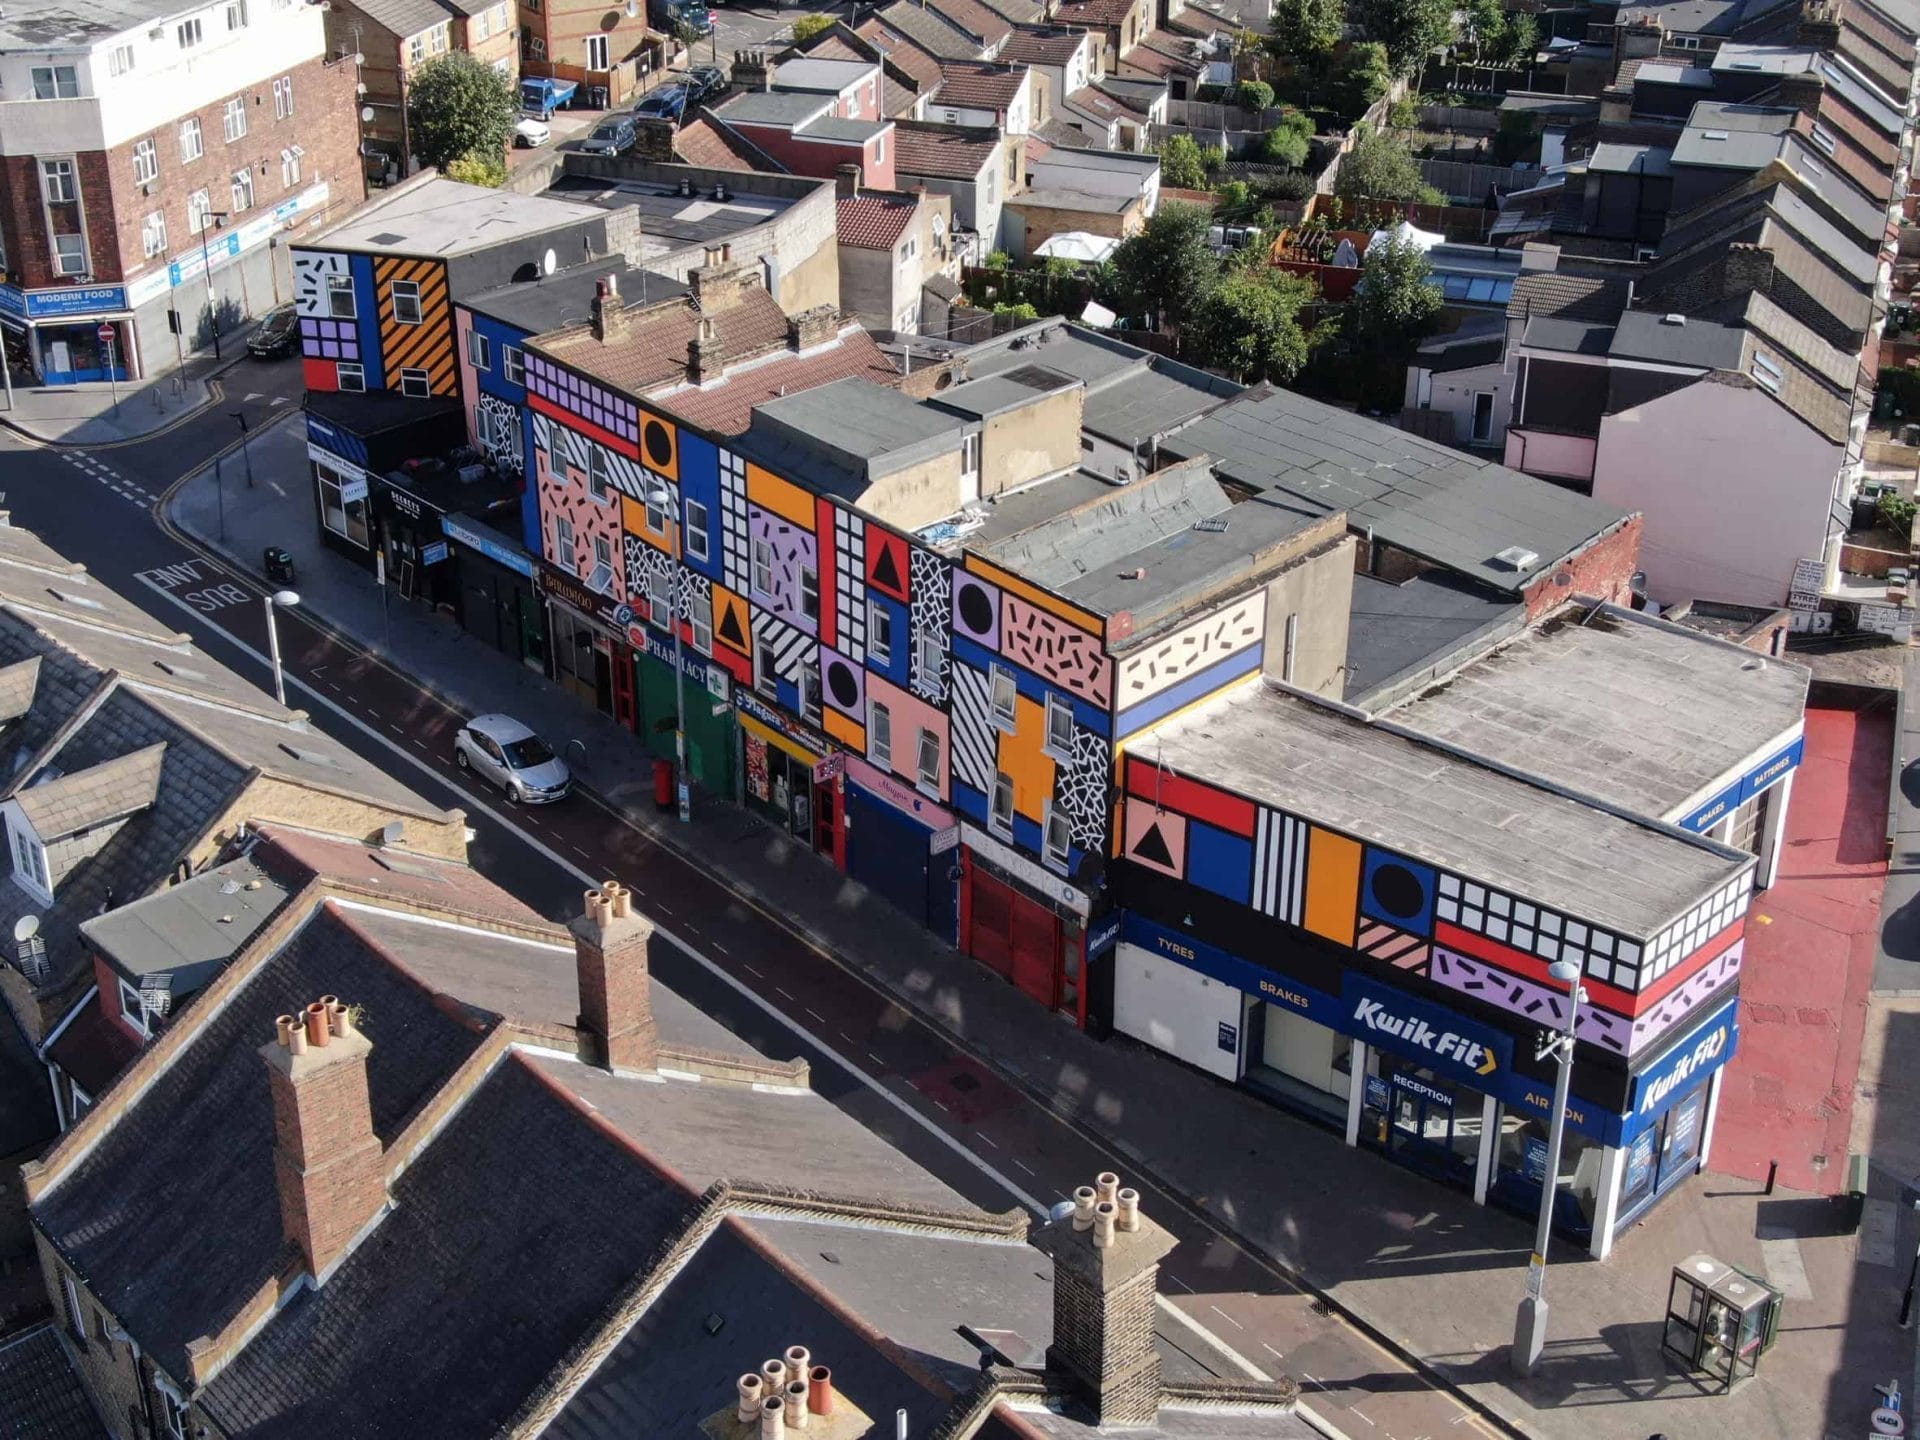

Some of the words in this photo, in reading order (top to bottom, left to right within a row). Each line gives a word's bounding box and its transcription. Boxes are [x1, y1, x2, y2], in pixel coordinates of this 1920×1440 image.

[36, 292, 82, 303] MODERN
[84, 290, 113, 299] FOOD
[139, 559, 224, 589] LANE
[185, 583, 251, 611] BUS
[1754, 755, 1790, 787] BATTERIES
[1697, 801, 1725, 828] BRAKES
[1158, 937, 1195, 960] TYRES
[1259, 980, 1309, 1008] BRAKES
[1354, 998, 1437, 1050] Kwik
[1435, 1032, 1487, 1068] Fit
[1393, 1073, 1453, 1106] RECEPTION
[1640, 1054, 1690, 1115] Kwik
[1525, 1092, 1549, 1110] AIR
[1564, 1111, 1584, 1125] ON
